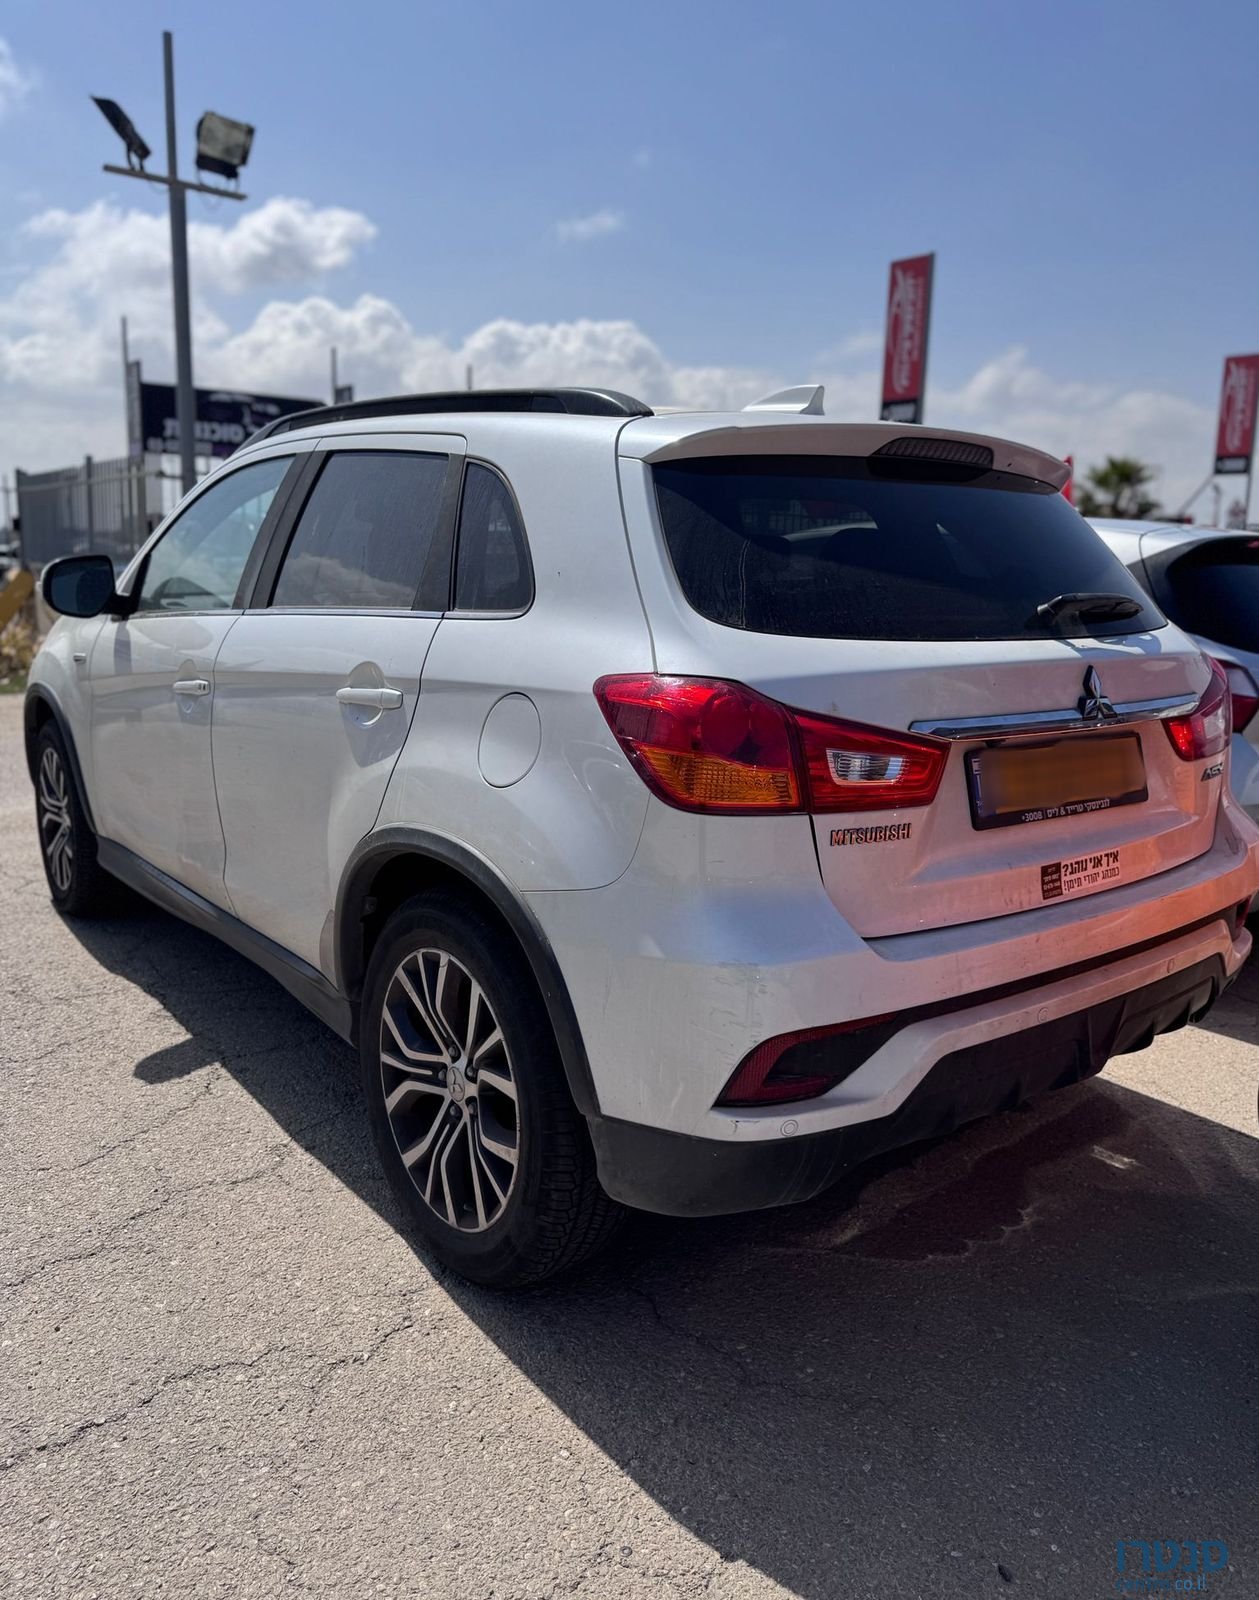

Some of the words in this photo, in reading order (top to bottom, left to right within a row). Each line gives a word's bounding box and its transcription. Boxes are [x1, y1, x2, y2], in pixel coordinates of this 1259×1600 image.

[830, 823, 912, 847] MITSUBISHI
[1089, 855, 1103, 869] אני
[1103, 850, 1119, 867] איך
[1062, 858, 1088, 877] נוהג?
[1101, 866, 1120, 880] כמנהג
[1064, 877, 1082, 892] תימן!
[1083, 871, 1100, 884] יהודי
